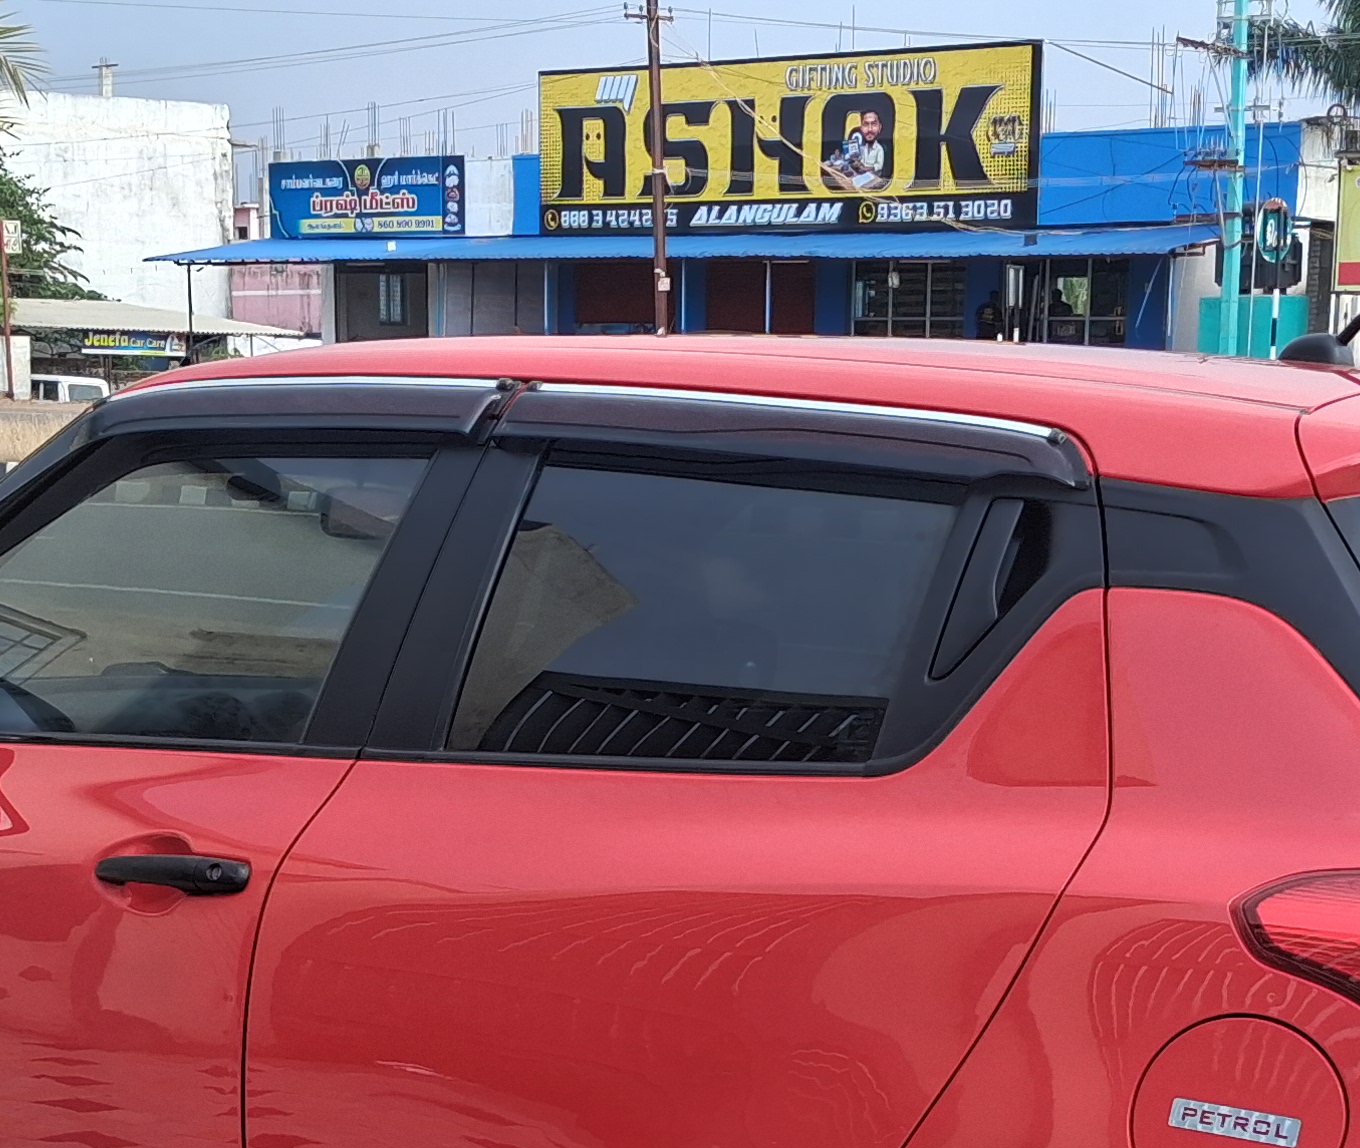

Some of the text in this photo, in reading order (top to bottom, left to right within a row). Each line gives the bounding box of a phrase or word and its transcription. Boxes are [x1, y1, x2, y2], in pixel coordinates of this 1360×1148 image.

[785, 57, 936, 90] GIFTING STUDIO
[552, 84, 1005, 201] ASHOK
[363, 190, 416, 211] மீட்ஸ்
[876, 202, 928, 222] 9363
[959, 199, 1012, 220] 3020
[560, 209, 678, 228] 888 3 42425
[690, 202, 843, 228] ALANGULAM
[84, 332, 165, 348] Jenefa Car Care
[1181, 1106, 1289, 1140] PETROL
